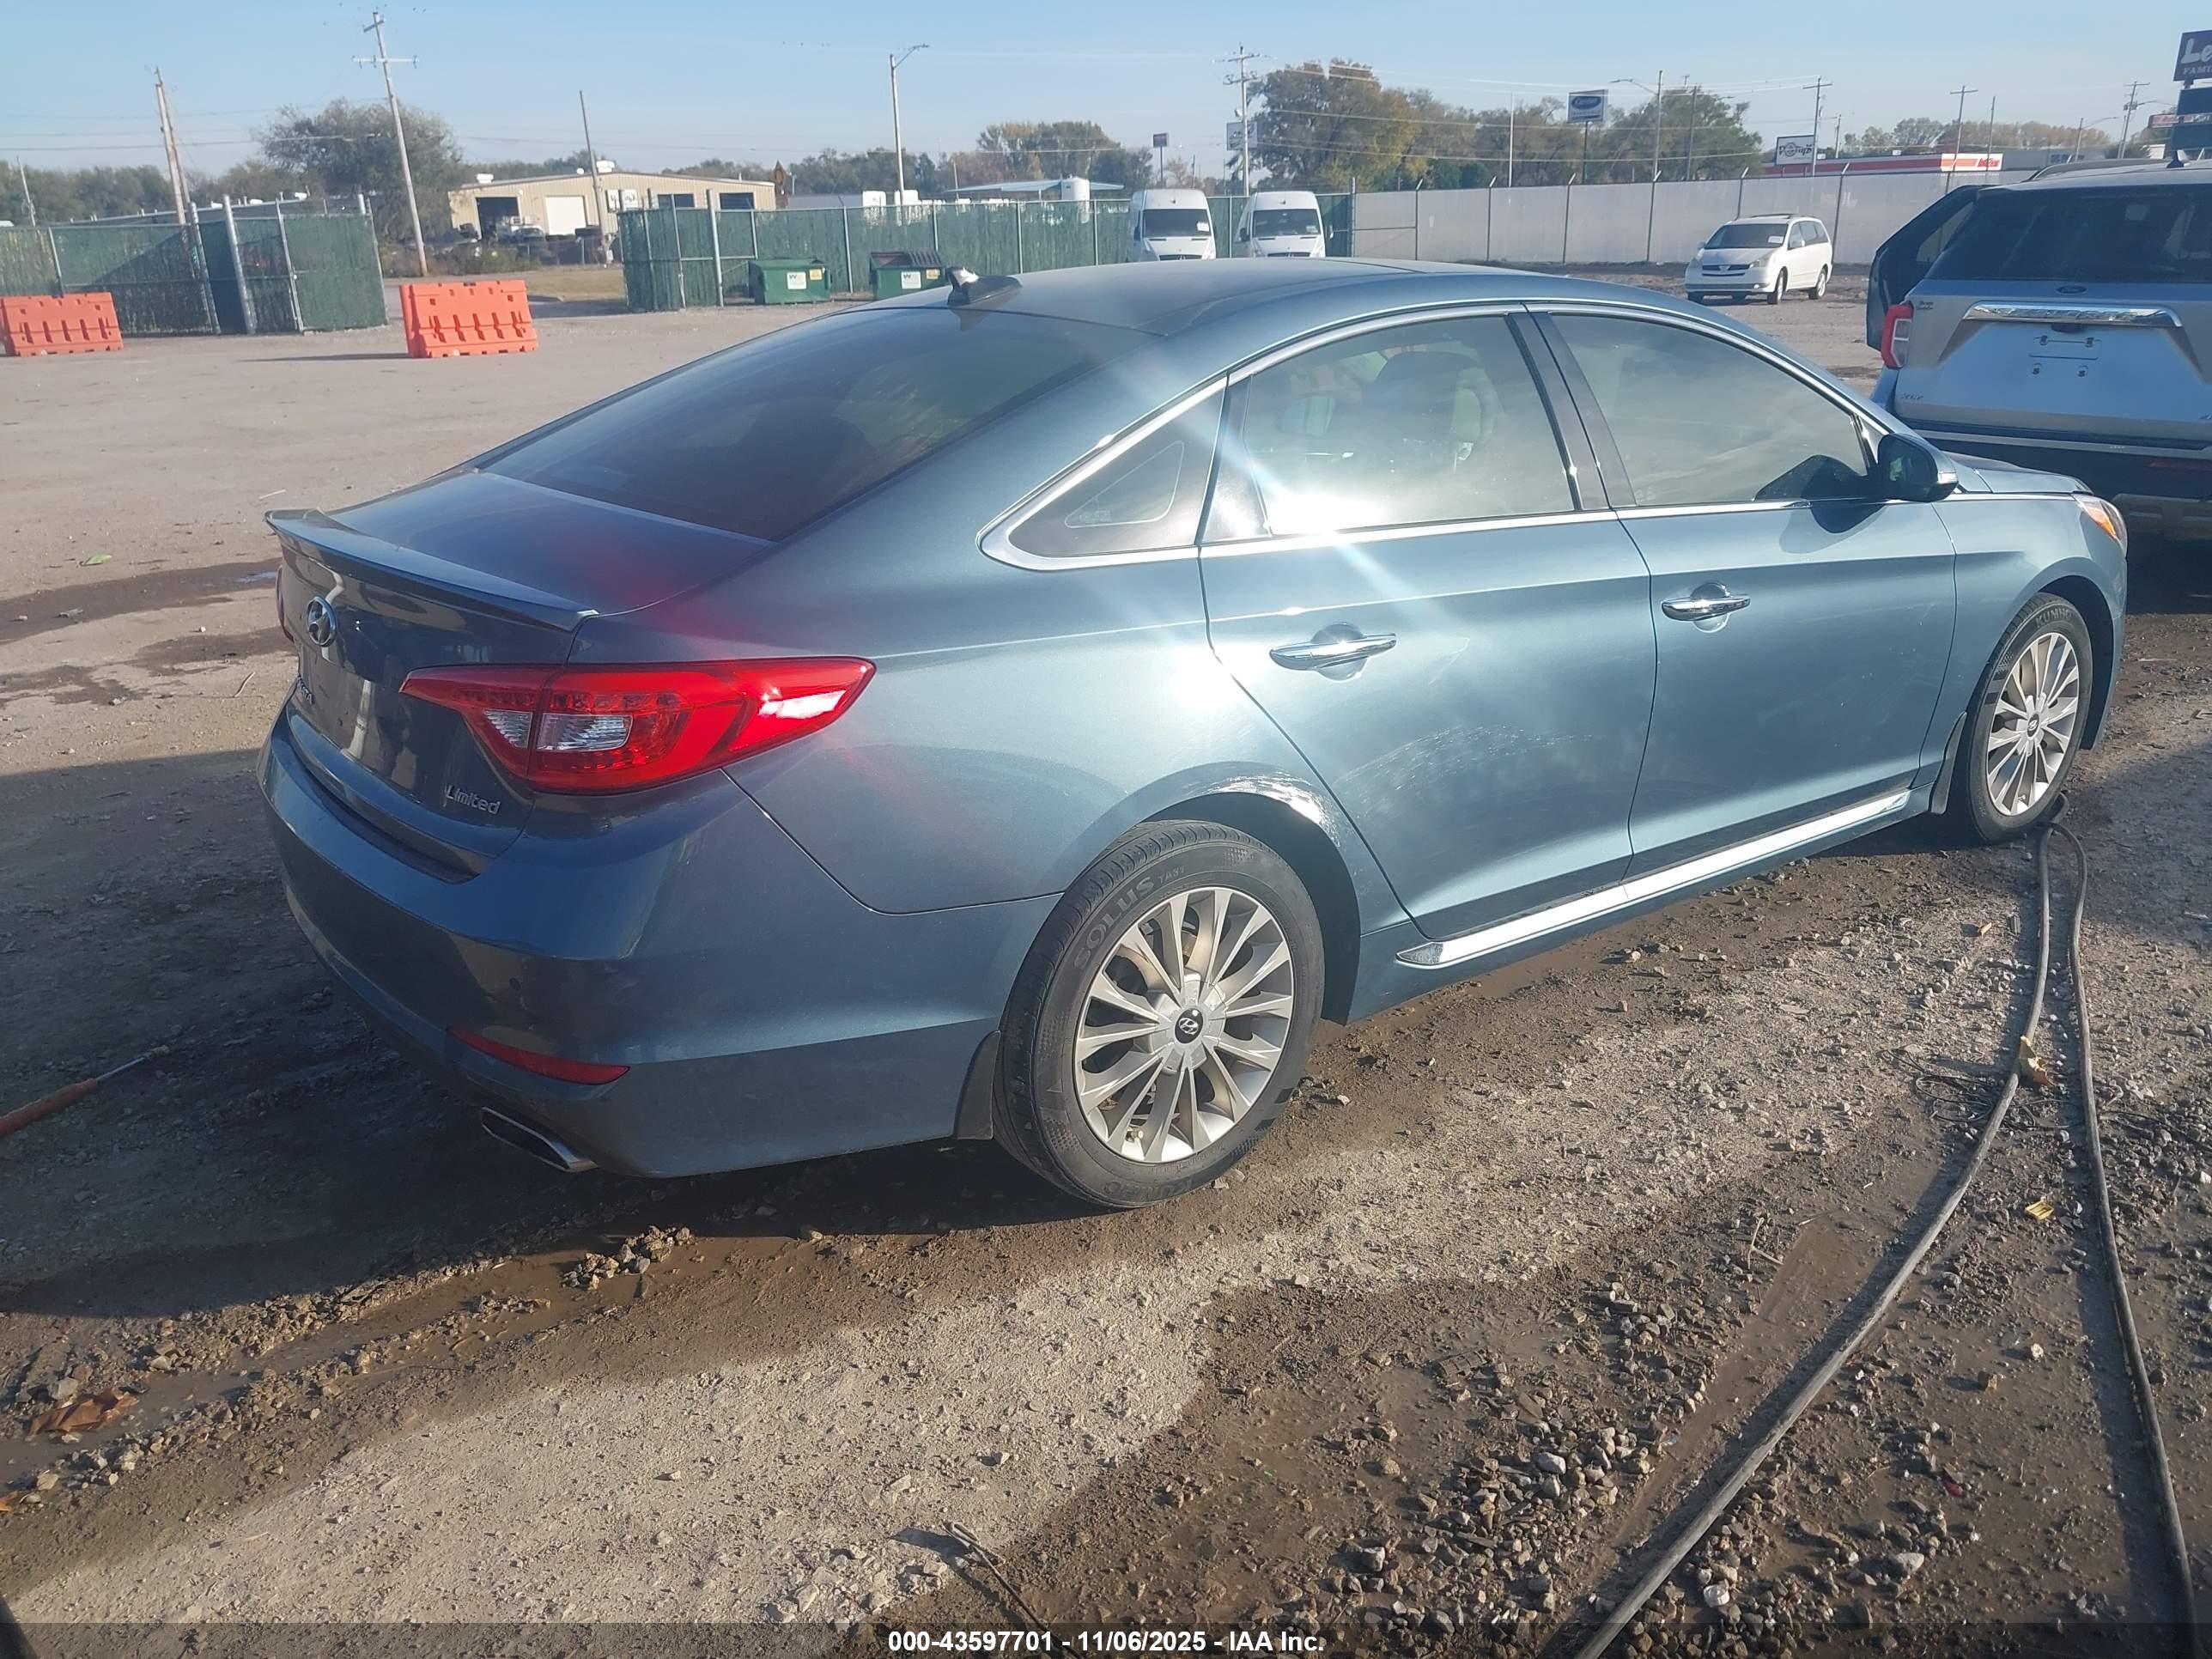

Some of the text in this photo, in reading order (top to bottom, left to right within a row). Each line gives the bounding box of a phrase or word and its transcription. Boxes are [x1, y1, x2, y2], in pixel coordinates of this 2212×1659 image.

[2184, 65, 2212, 76] FAMI
[446, 784, 501, 815] Limited
[1073, 866, 1185, 969] SOLUS TA31
